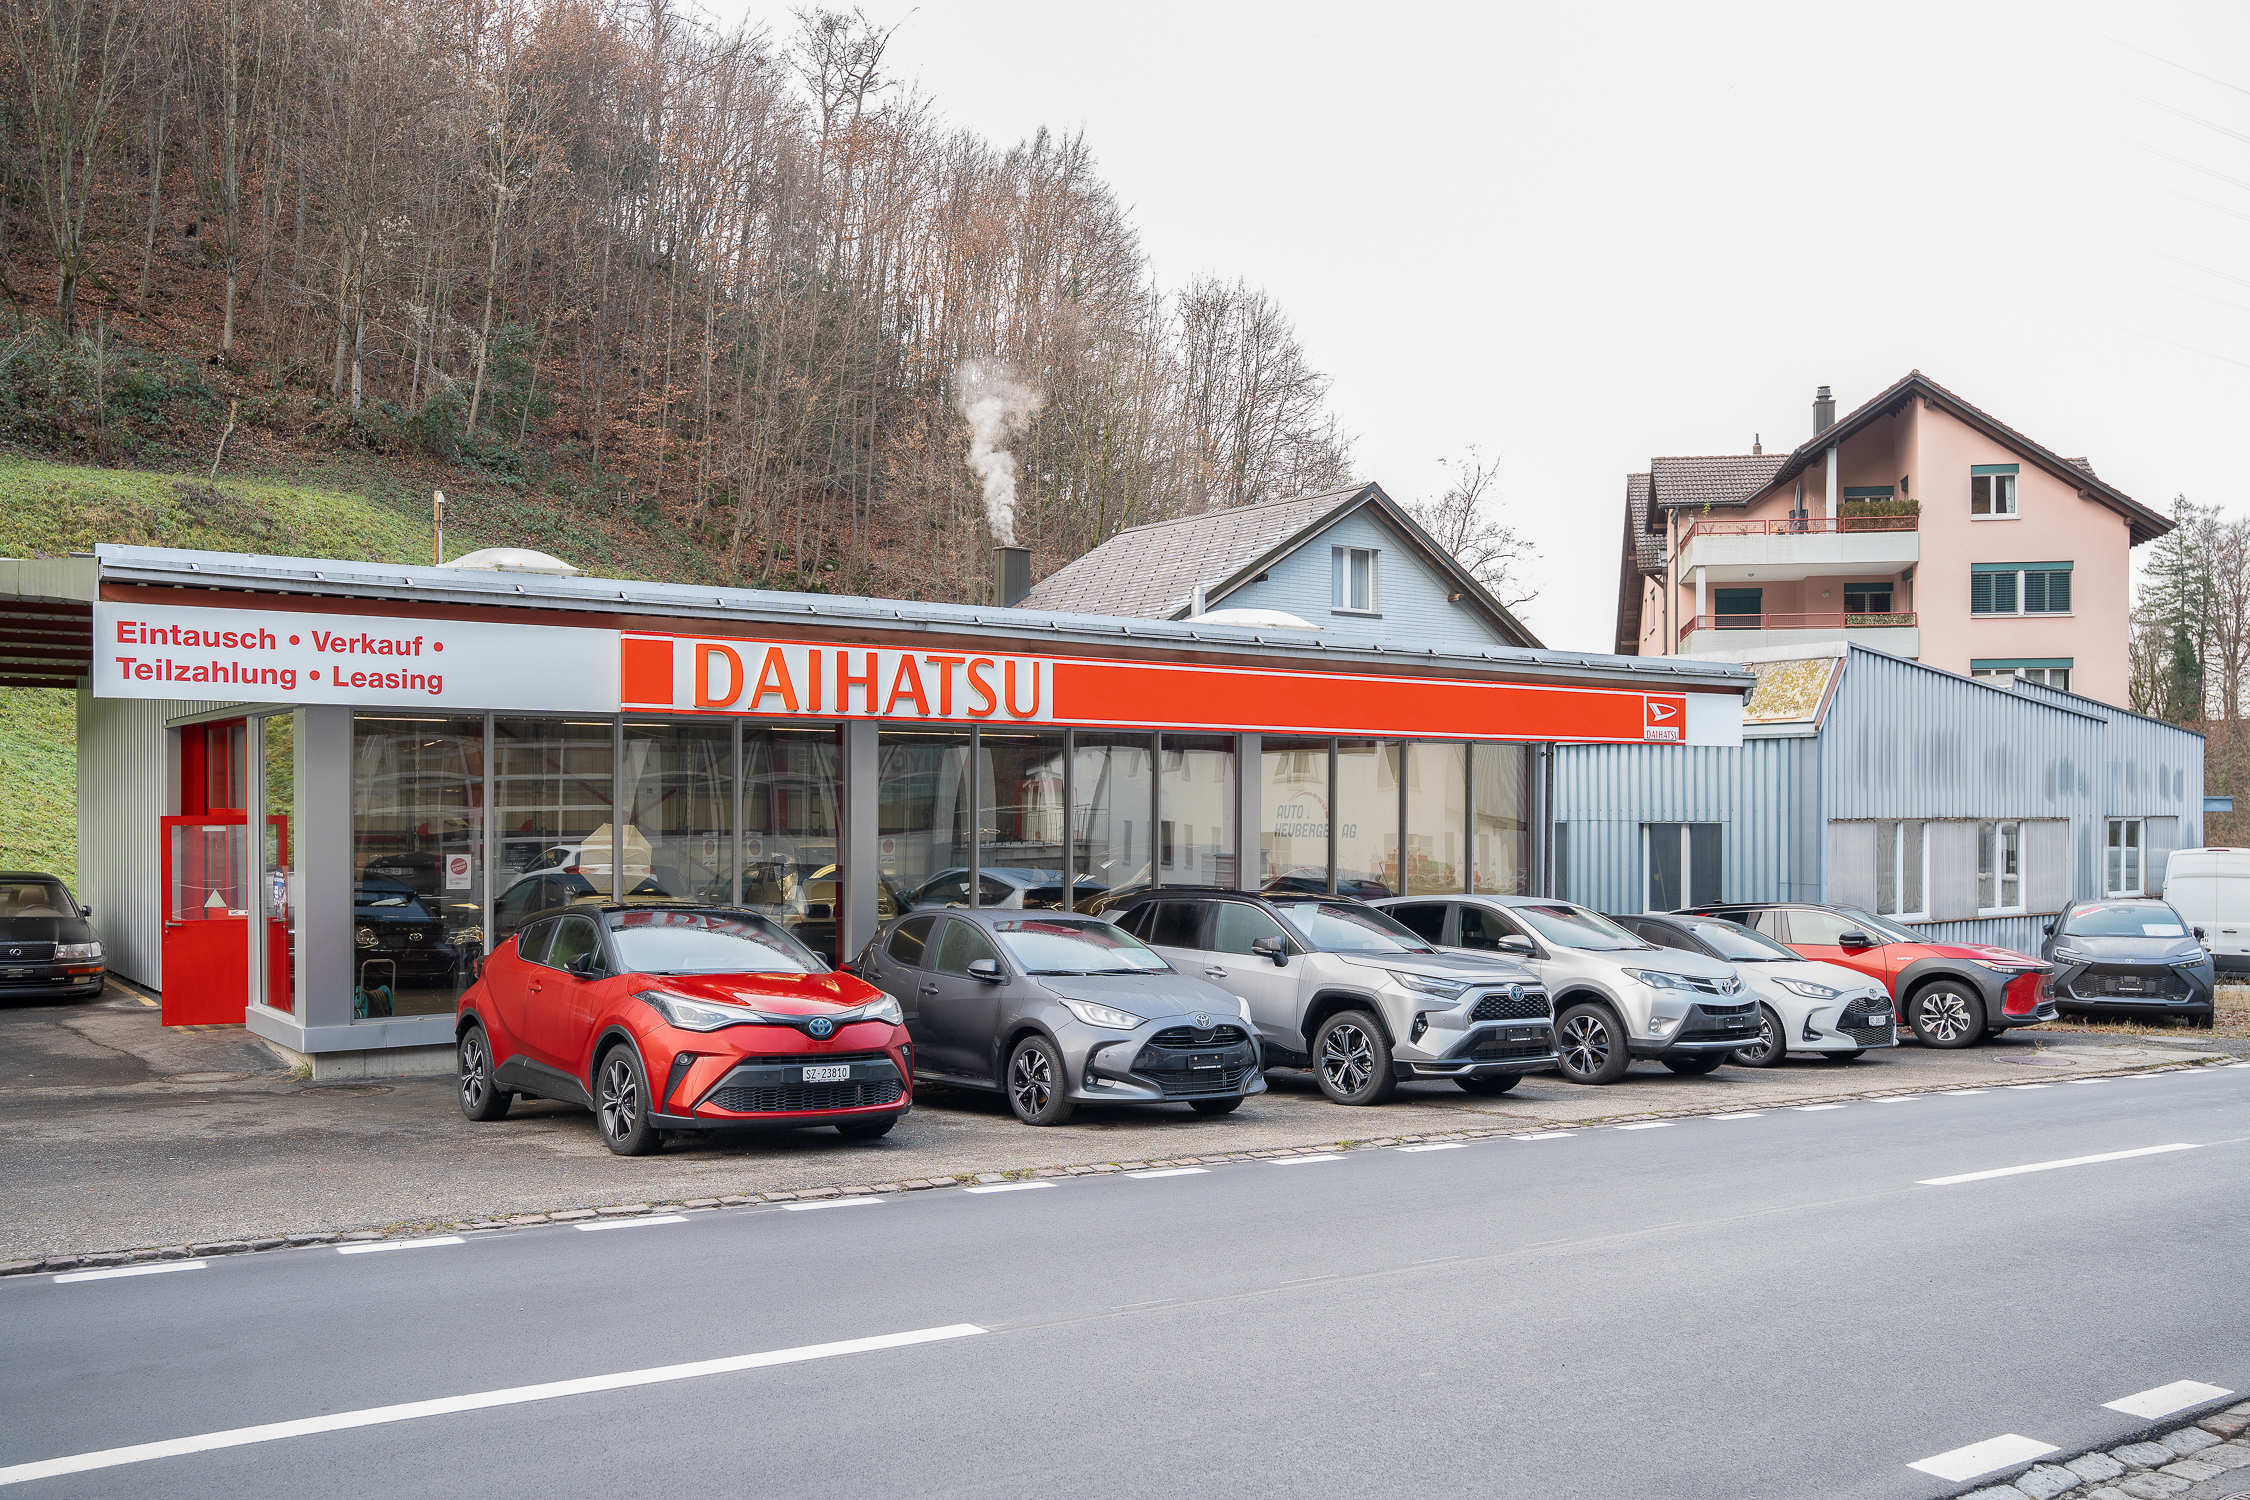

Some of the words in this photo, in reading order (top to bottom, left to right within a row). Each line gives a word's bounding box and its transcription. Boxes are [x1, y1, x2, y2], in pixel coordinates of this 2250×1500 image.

[116, 621, 276, 650] Eintausch
[311, 630, 423, 657] Verkauf
[115, 656, 297, 691] Teilzahlung
[332, 665, 443, 695] Leasing
[693, 643, 1040, 719] DAIHATSU
[1646, 730, 1679, 740] DAIHATSU
[1276, 804, 1304, 820] AUTO
[1273, 822, 1329, 839] HEUBERGE
[1341, 823, 1357, 839] AG
